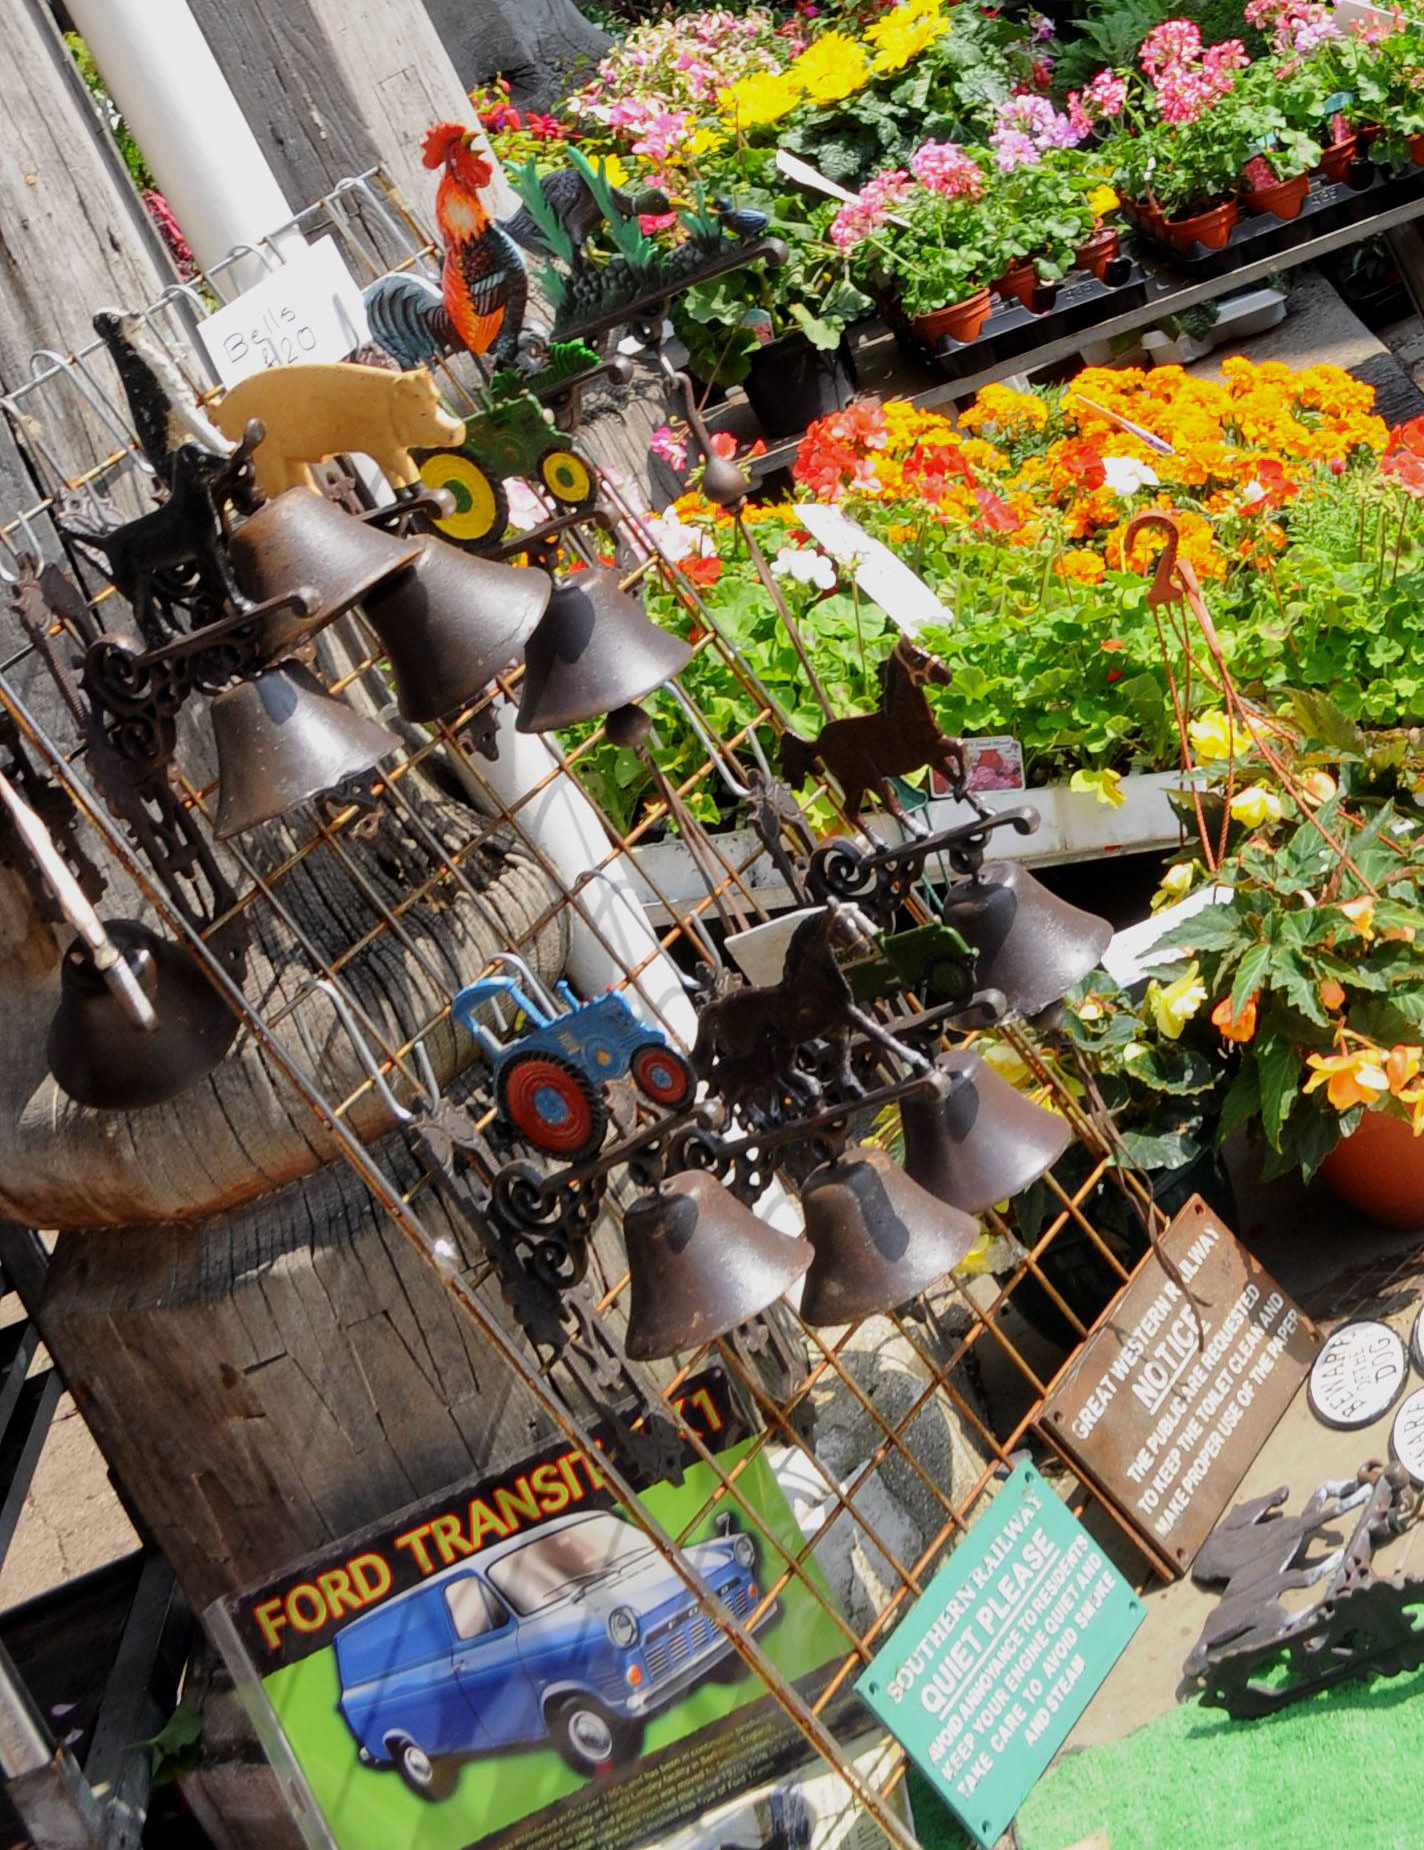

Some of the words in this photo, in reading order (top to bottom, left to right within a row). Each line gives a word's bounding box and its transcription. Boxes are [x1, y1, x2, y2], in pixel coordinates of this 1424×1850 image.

[223, 306, 296, 364] Bells
[1071, 1372, 1119, 1440] GREAT
[1110, 1295, 1174, 1384] WESTERN
[1127, 1450, 1154, 1485] THE
[1147, 1393, 1187, 1457] PUBLIC
[1181, 1361, 1208, 1403] ARE
[1202, 1283, 1261, 1372] REQUESTED
[1137, 1487, 1160, 1515] TO
[1154, 1448, 1182, 1495] KEEP
[1176, 1420, 1204, 1453] THE
[1198, 1366, 1234, 1422] TOILET
[1228, 1324, 1266, 1374] CLEAN
[1258, 1291, 1284, 1331] AND
[1154, 1493, 1189, 1539] MAKE
[1183, 1431, 1225, 1496] PROPER
[1219, 1400, 1244, 1440] USE
[1237, 1381, 1256, 1407] OF
[1249, 1355, 1275, 1387] THE
[1266, 1307, 1302, 1359] PAPER
[1320, 1331, 1368, 1418] BEWARE
[1368, 1336, 1399, 1386] DOG
[253, 1551, 393, 1651] FORD
[396, 1437, 608, 1577] TRANSIT
[887, 1586, 978, 1704] SOUTHERN
[968, 1494, 1043, 1592] RAILWAY
[919, 1624, 982, 1715] QUIET
[975, 1526, 1056, 1637] PLEASE
[928, 1714, 966, 1766] AVOID
[959, 1632, 1024, 1721] ANNOYANCE
[1018, 1602, 1039, 1636] TO
[1033, 1533, 1089, 1612] RESIDENTS
[941, 1732, 976, 1783] KEEP
[973, 1687, 1009, 1736] YOUR
[1003, 1630, 1050, 1693] ENGINE
[1044, 1586, 1081, 1635] QUIET
[1073, 1552, 1103, 1592] AND
[956, 1752, 994, 1800] TAKE
[990, 1702, 1028, 1753] CARE
[1021, 1676, 1044, 1704] TO
[1041, 1625, 1078, 1682] AVOID
[1073, 1569, 1118, 1630] SMOKE
[1023, 1706, 1052, 1748] AND
[1044, 1653, 1087, 1712] STEAM
